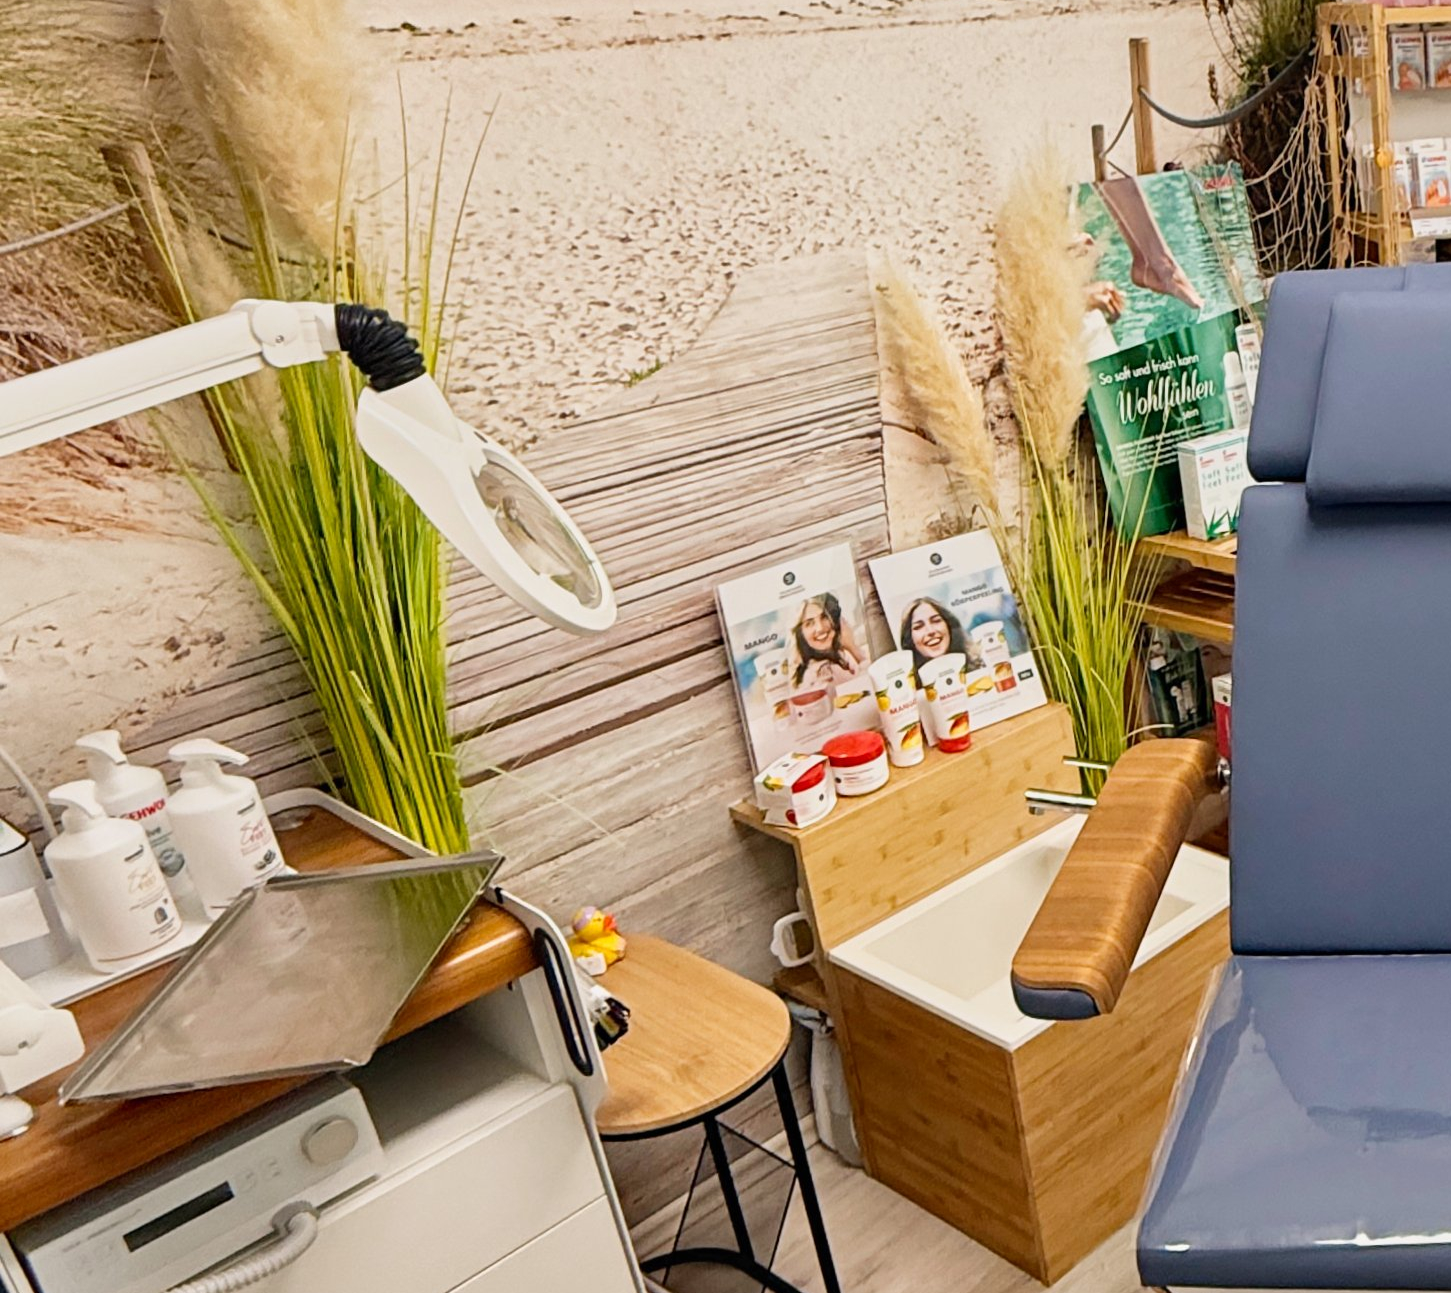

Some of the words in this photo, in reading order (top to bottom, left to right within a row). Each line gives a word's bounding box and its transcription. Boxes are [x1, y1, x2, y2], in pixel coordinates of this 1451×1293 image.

[1099, 372, 1112, 385] So
[1114, 365, 1131, 381] soft
[1133, 361, 1151, 377] und
[1151, 355, 1176, 373] frisch
[1177, 353, 1199, 366] kann
[1116, 369, 1216, 425] Wohlfühlen
[744, 633, 778, 651] MANGO
[123, 798, 166, 821] EHWO
